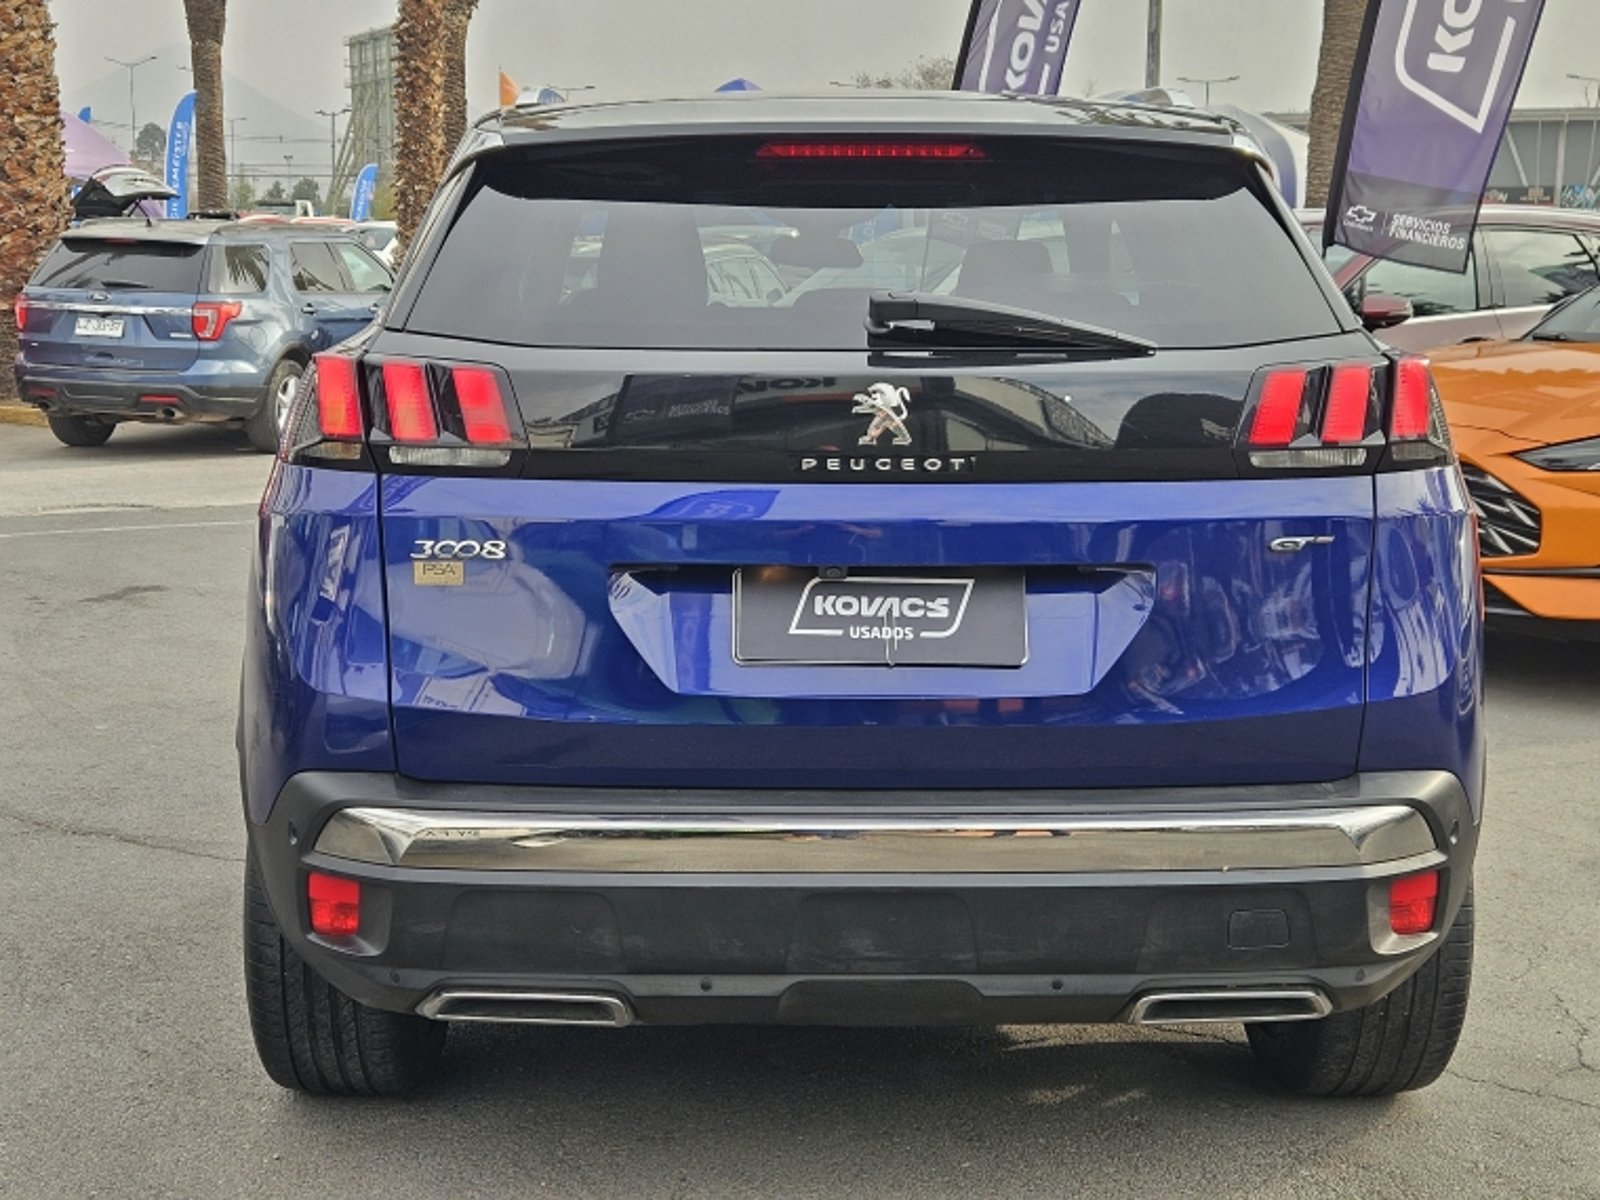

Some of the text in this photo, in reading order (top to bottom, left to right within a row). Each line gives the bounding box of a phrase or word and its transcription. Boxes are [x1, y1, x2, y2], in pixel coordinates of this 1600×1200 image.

[1002, 0, 1048, 95] KOV
[1391, 213, 1451, 235] SERVICIOS
[1388, 224, 1465, 250] FINANCIEROS
[802, 458, 965, 471] PEUGEOT
[410, 540, 506, 559] 3008
[422, 563, 456, 576] PSA
[814, 595, 950, 618] KOVACS
[850, 626, 914, 640] USADOS
